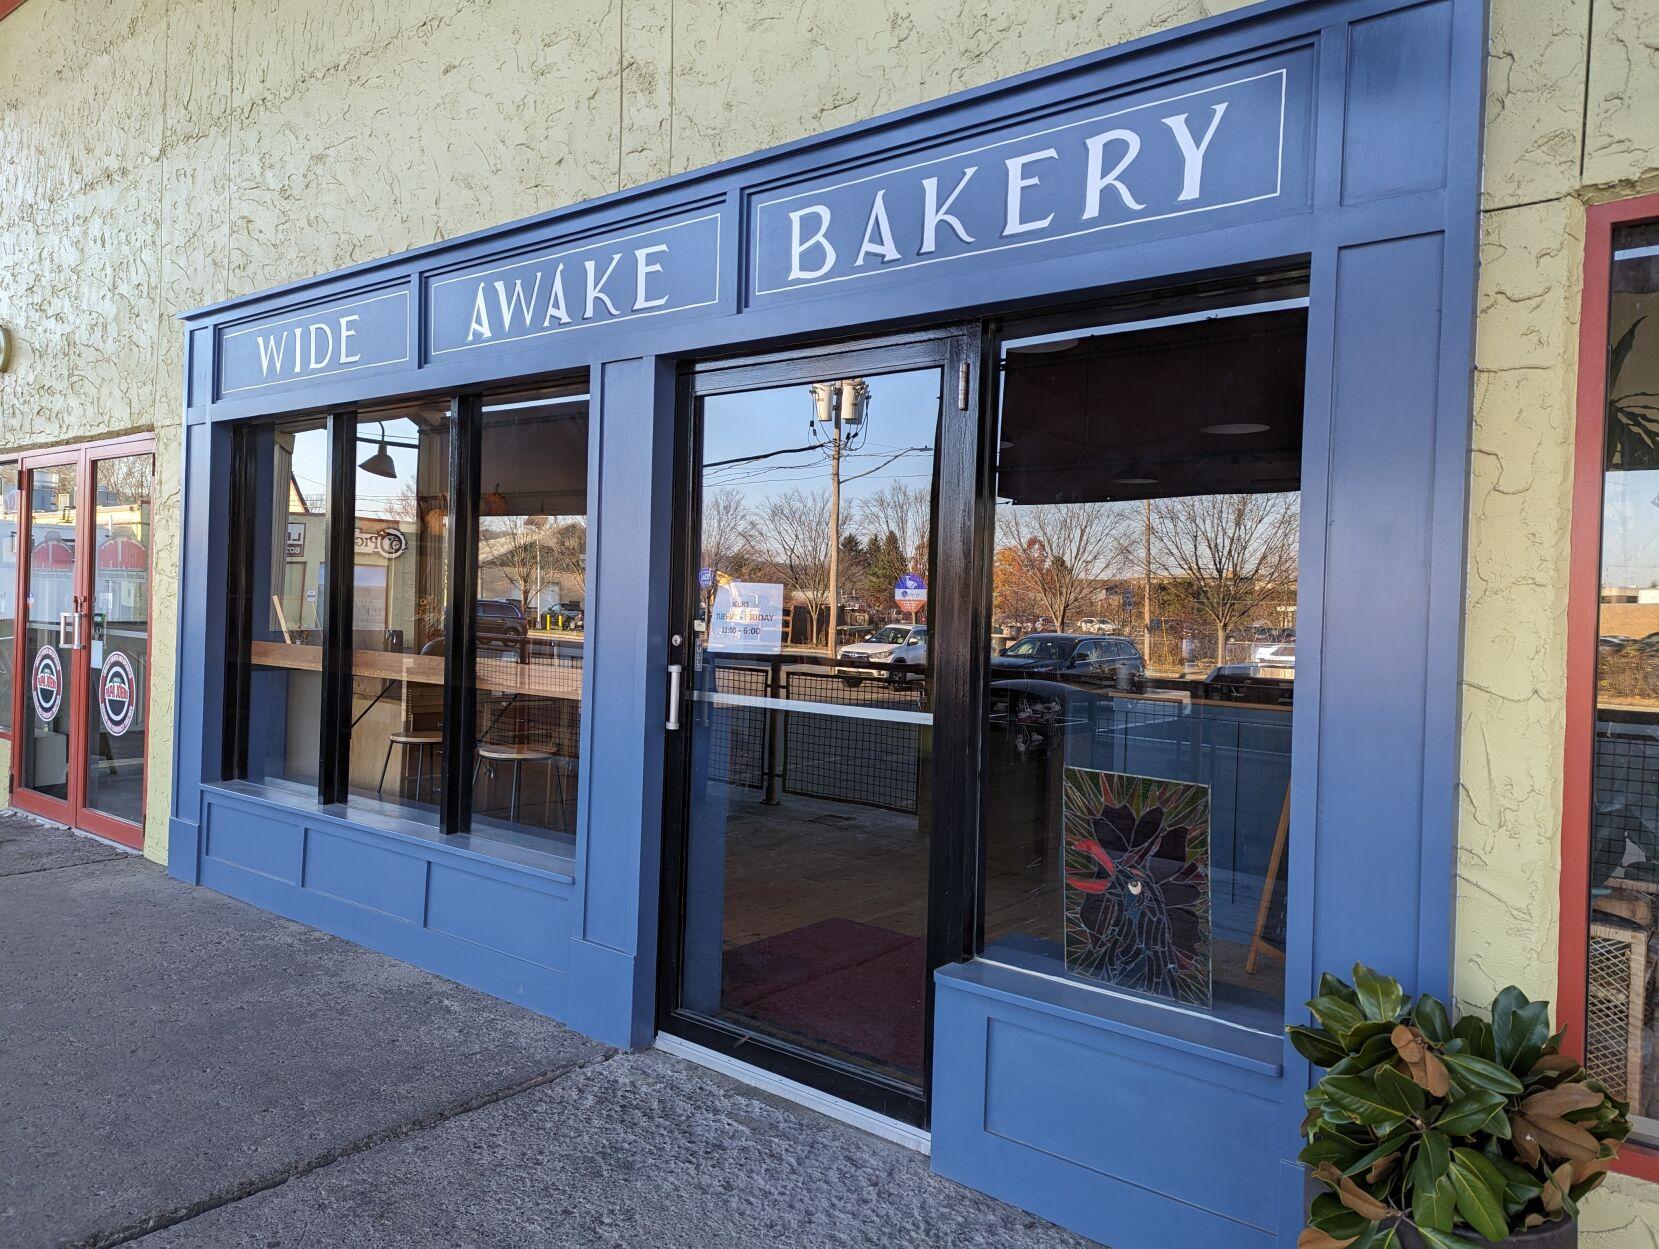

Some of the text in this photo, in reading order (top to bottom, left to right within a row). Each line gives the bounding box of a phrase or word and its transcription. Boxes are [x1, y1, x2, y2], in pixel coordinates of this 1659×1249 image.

[256, 102, 1229, 377] WIDE AWAKE BAKERY
[747, 612, 775, 622] RIDAY
[743, 626, 761, 635] 6:00
